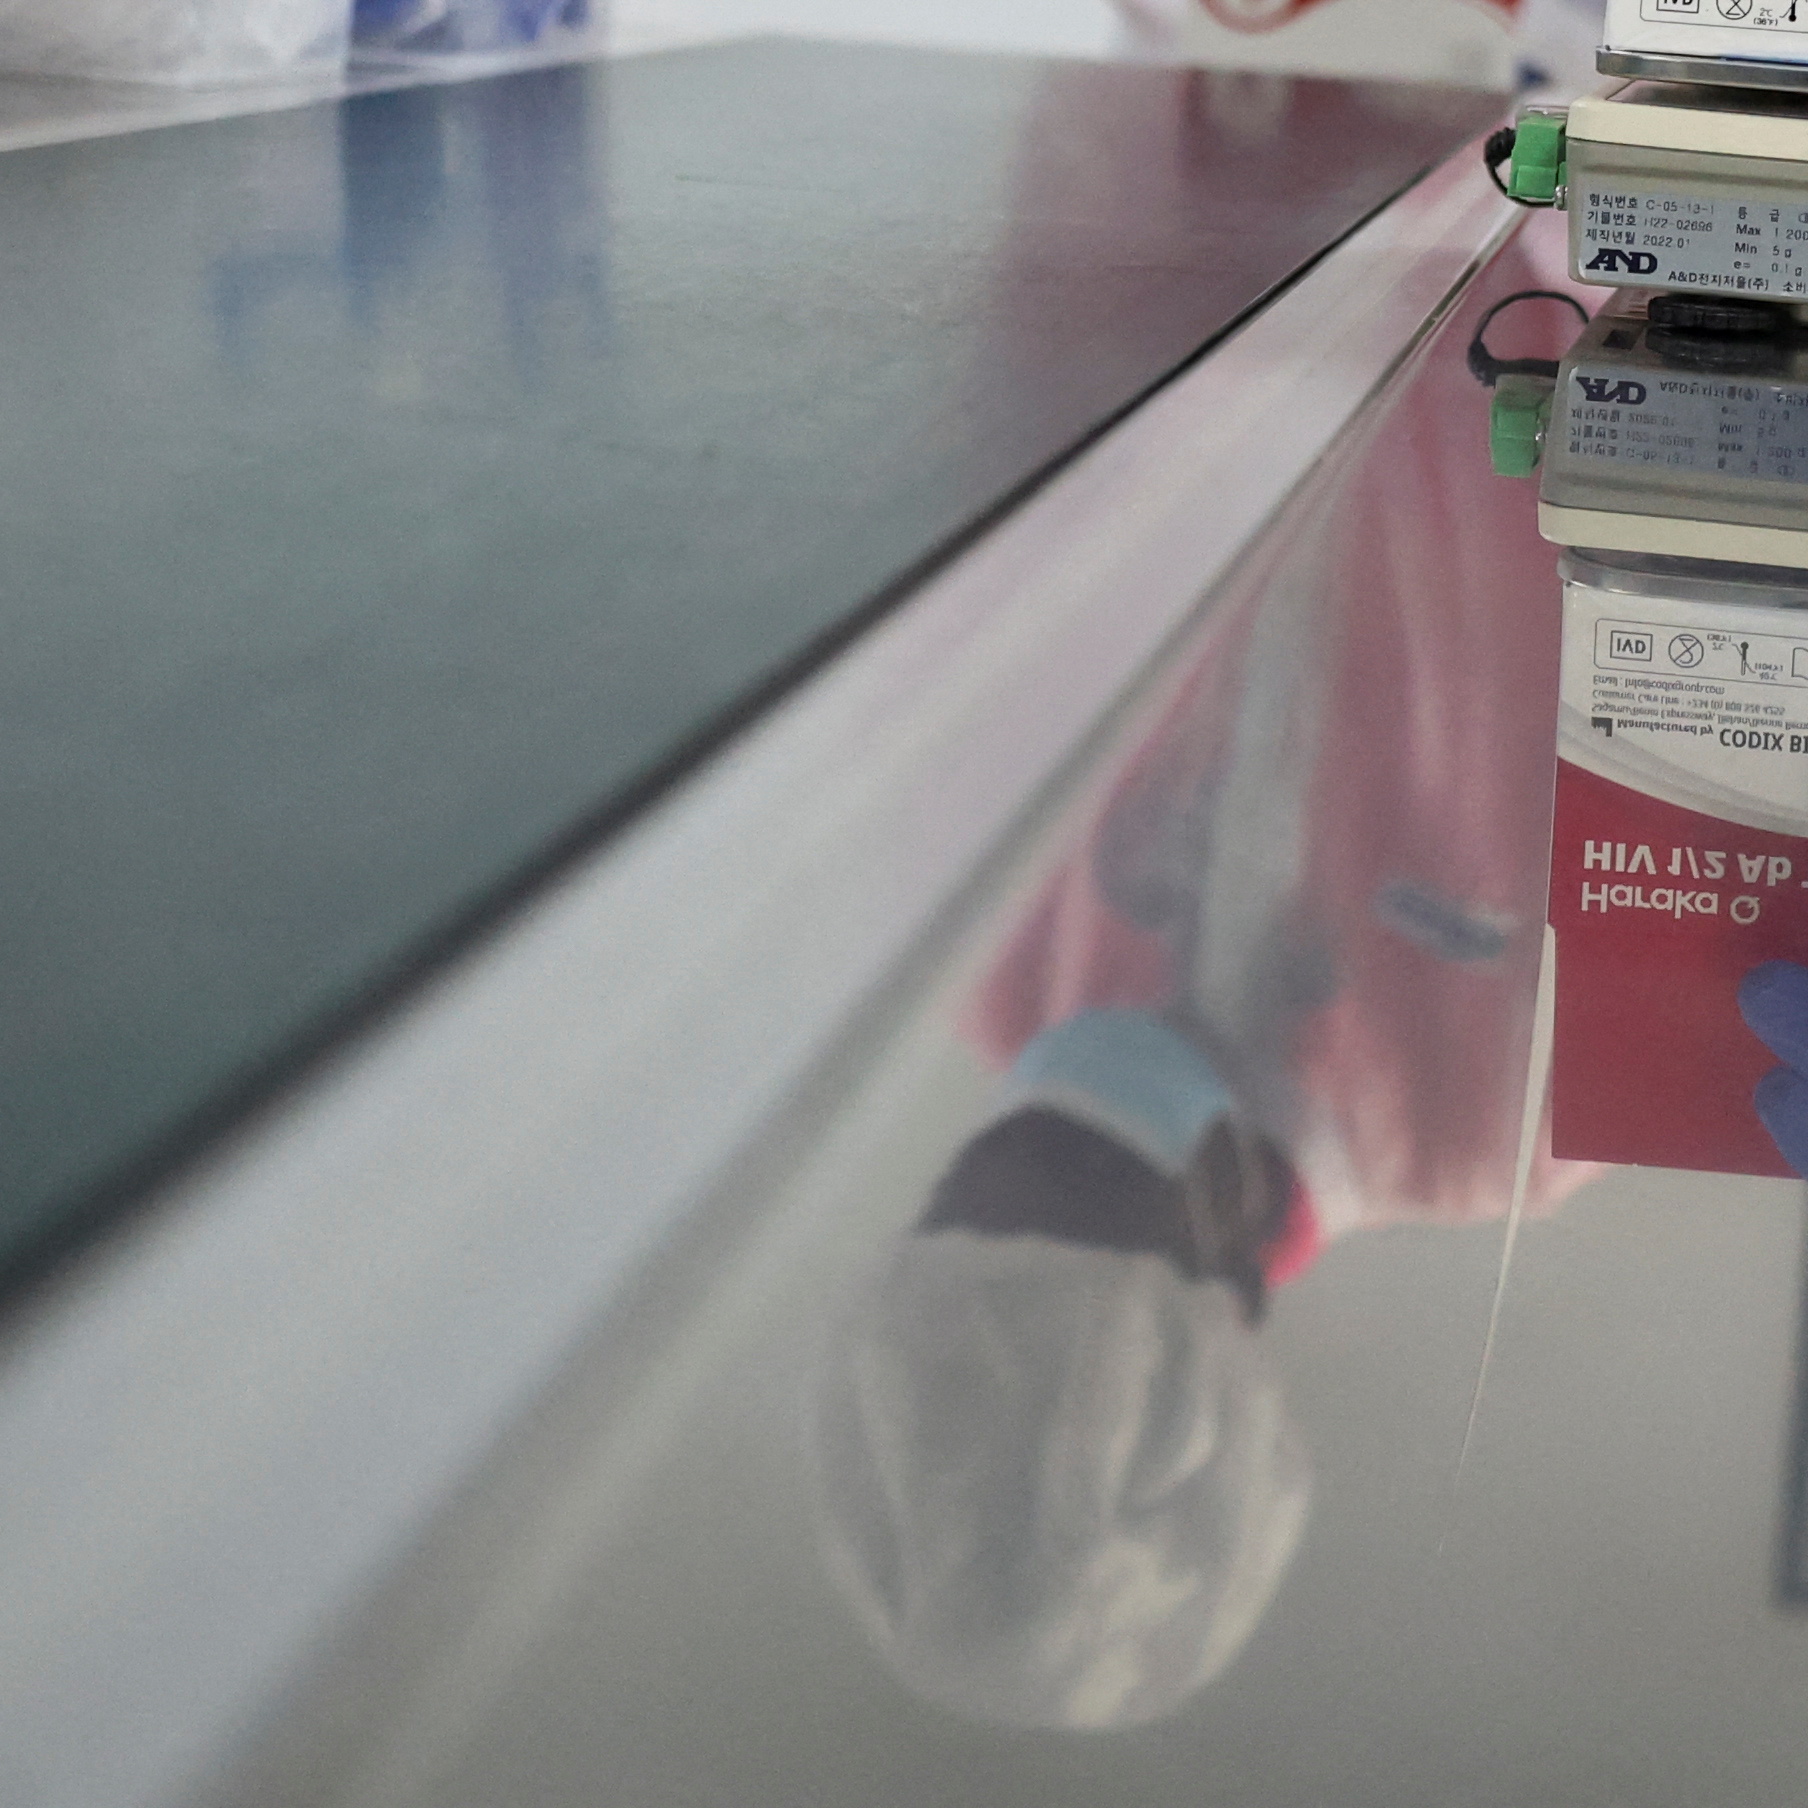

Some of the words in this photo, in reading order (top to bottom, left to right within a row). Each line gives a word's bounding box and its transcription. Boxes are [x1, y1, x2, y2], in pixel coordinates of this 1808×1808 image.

[1735, 223, 1761, 236] Max
[1734, 242, 1758, 254] Min
[1586, 248, 1657, 274] AND
